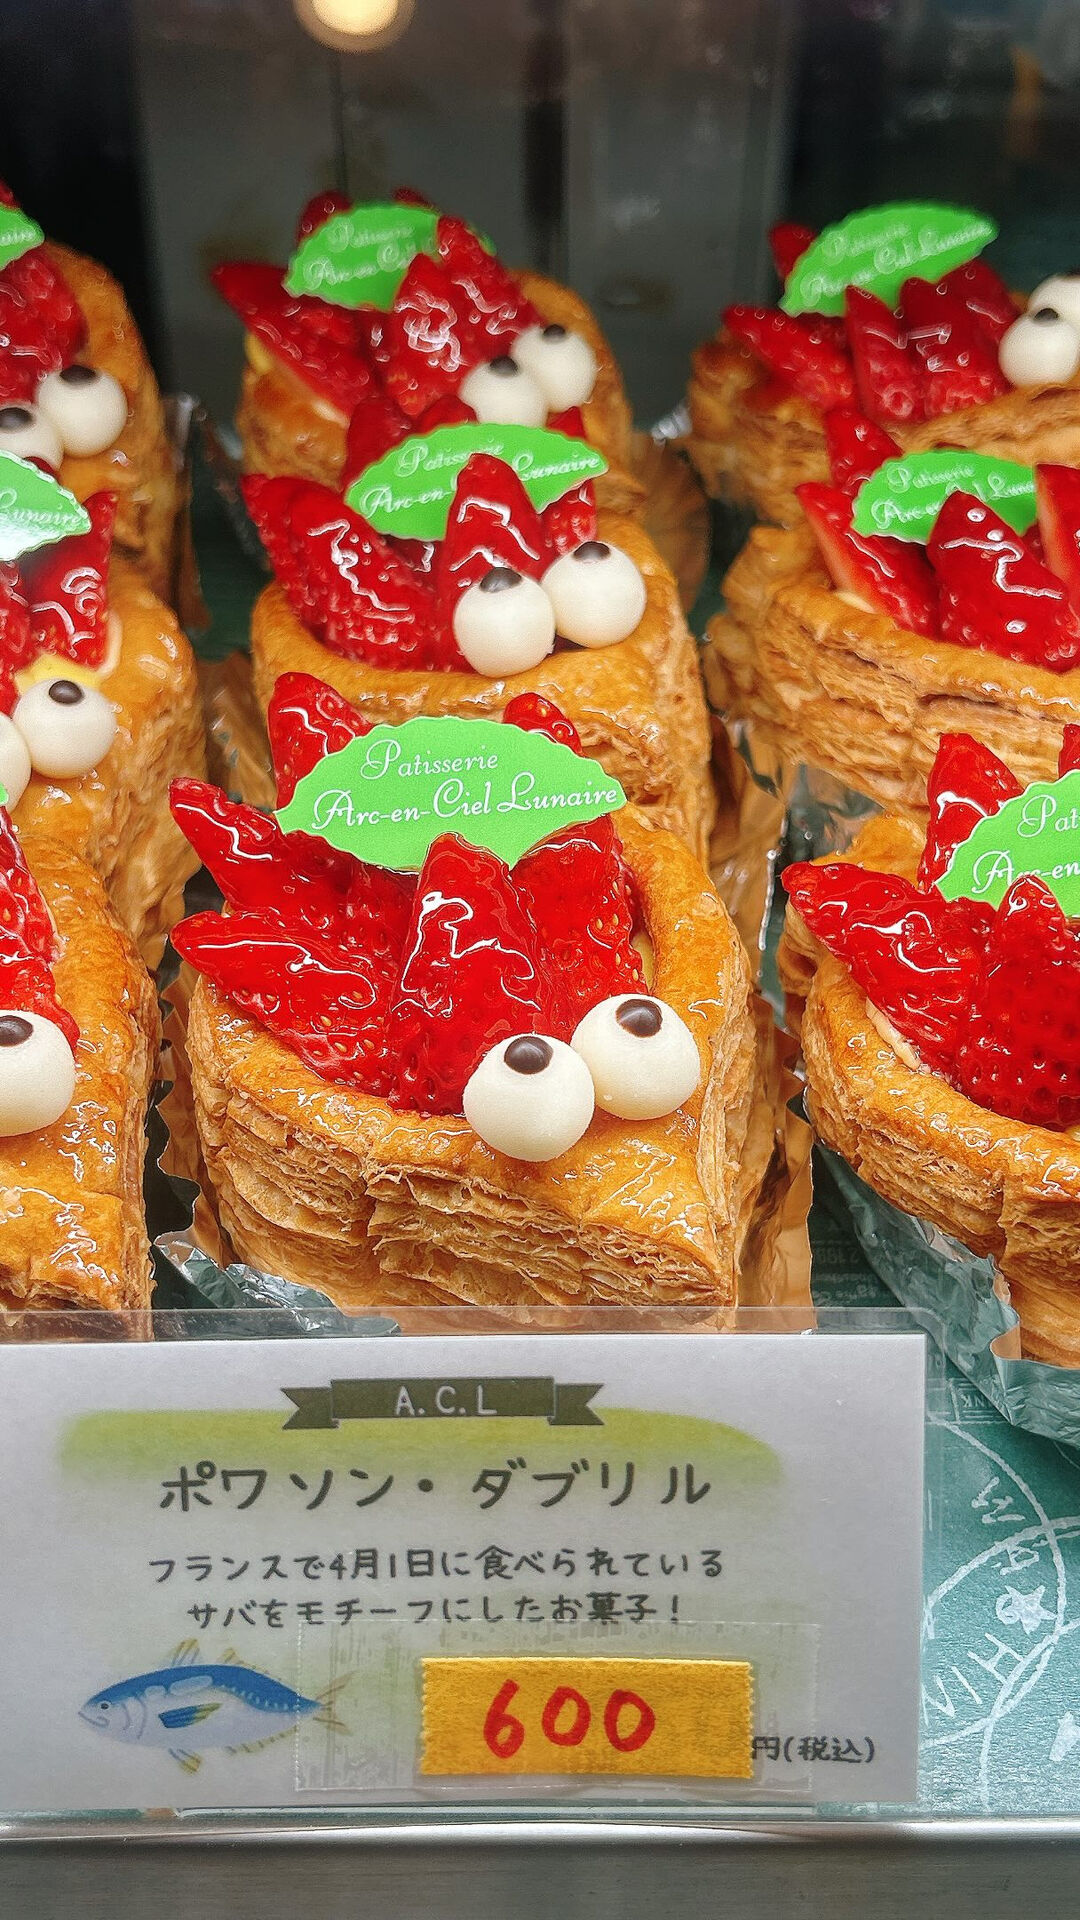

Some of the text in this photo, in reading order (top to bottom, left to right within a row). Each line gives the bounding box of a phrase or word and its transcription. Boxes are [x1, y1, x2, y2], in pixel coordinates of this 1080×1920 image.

[360, 738, 499, 780] Patisserie
[311, 771, 618, 830] Arc-en-Ciel Lunaire
[160, 1457, 711, 1512] ポワソン・ダブリル
[149, 1545, 723, 1583] フランスで4月1日に食べられている
[483, 1678, 656, 1759] 600
